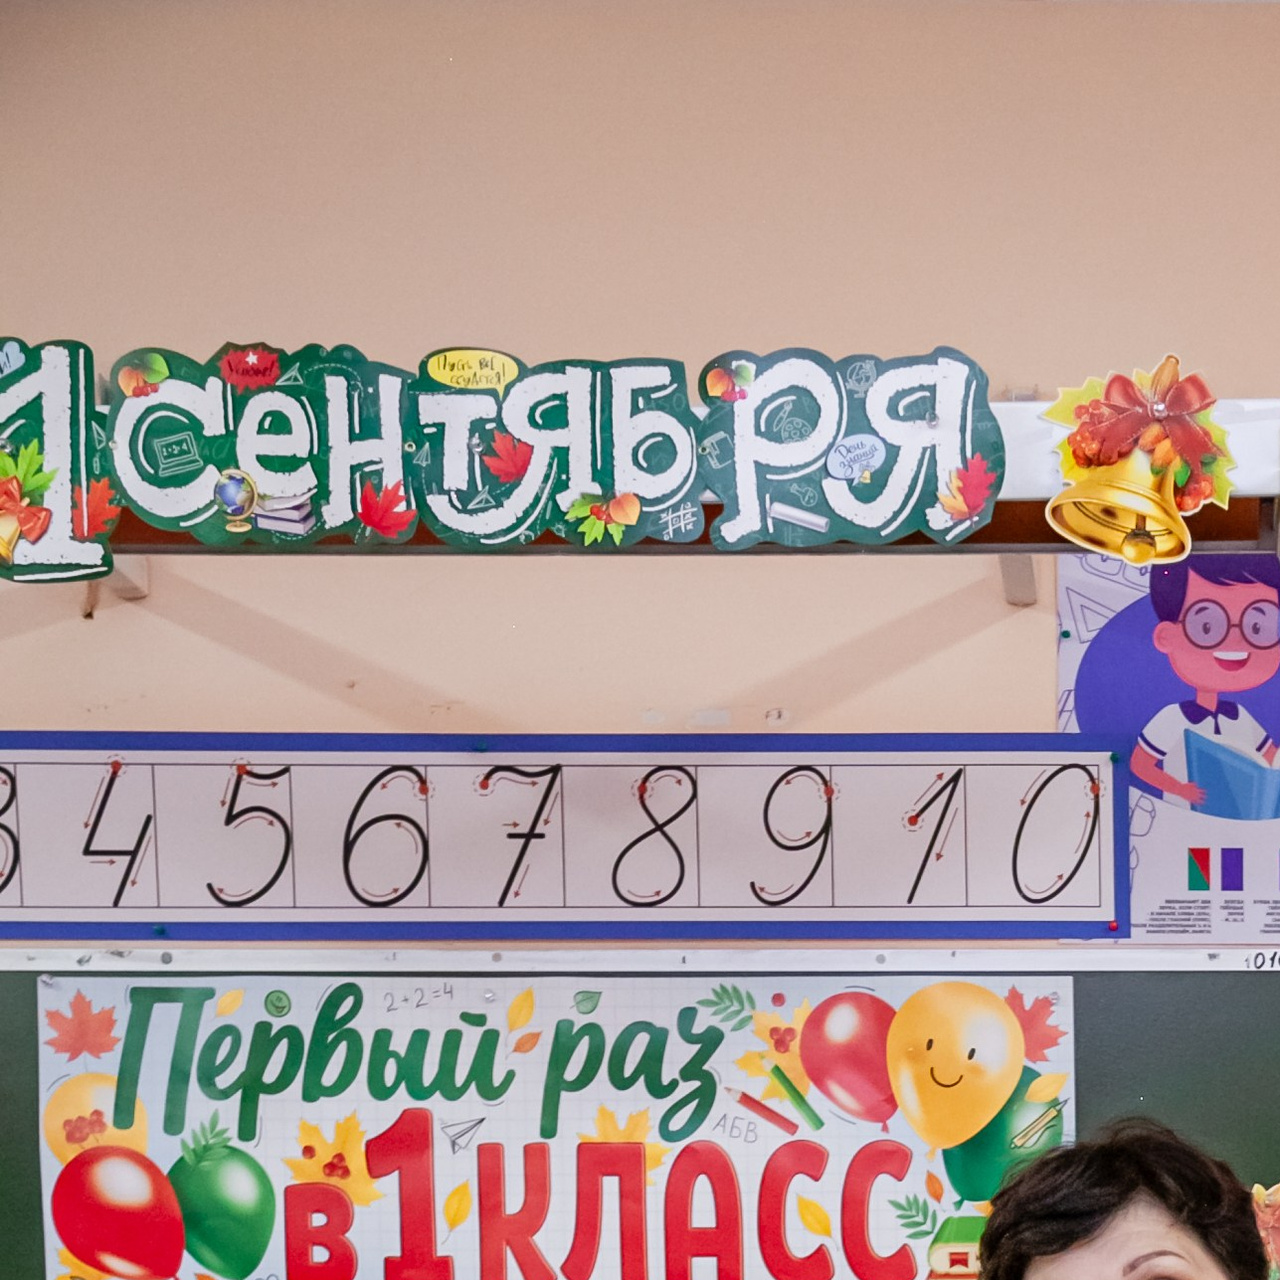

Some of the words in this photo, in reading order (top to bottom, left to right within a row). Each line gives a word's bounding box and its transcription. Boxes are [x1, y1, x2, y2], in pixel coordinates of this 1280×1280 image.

[83, 764, 153, 908] 4
[206, 764, 292, 908] 5
[343, 765, 429, 908] 6
[482, 763, 563, 908] 7
[612, 764, 698, 908] 8
[750, 764, 832, 907] 9
[114, 982, 515, 1142] Первый
[540, 1005, 725, 1143] раз
[712, 1113, 758, 1144] АБВ
